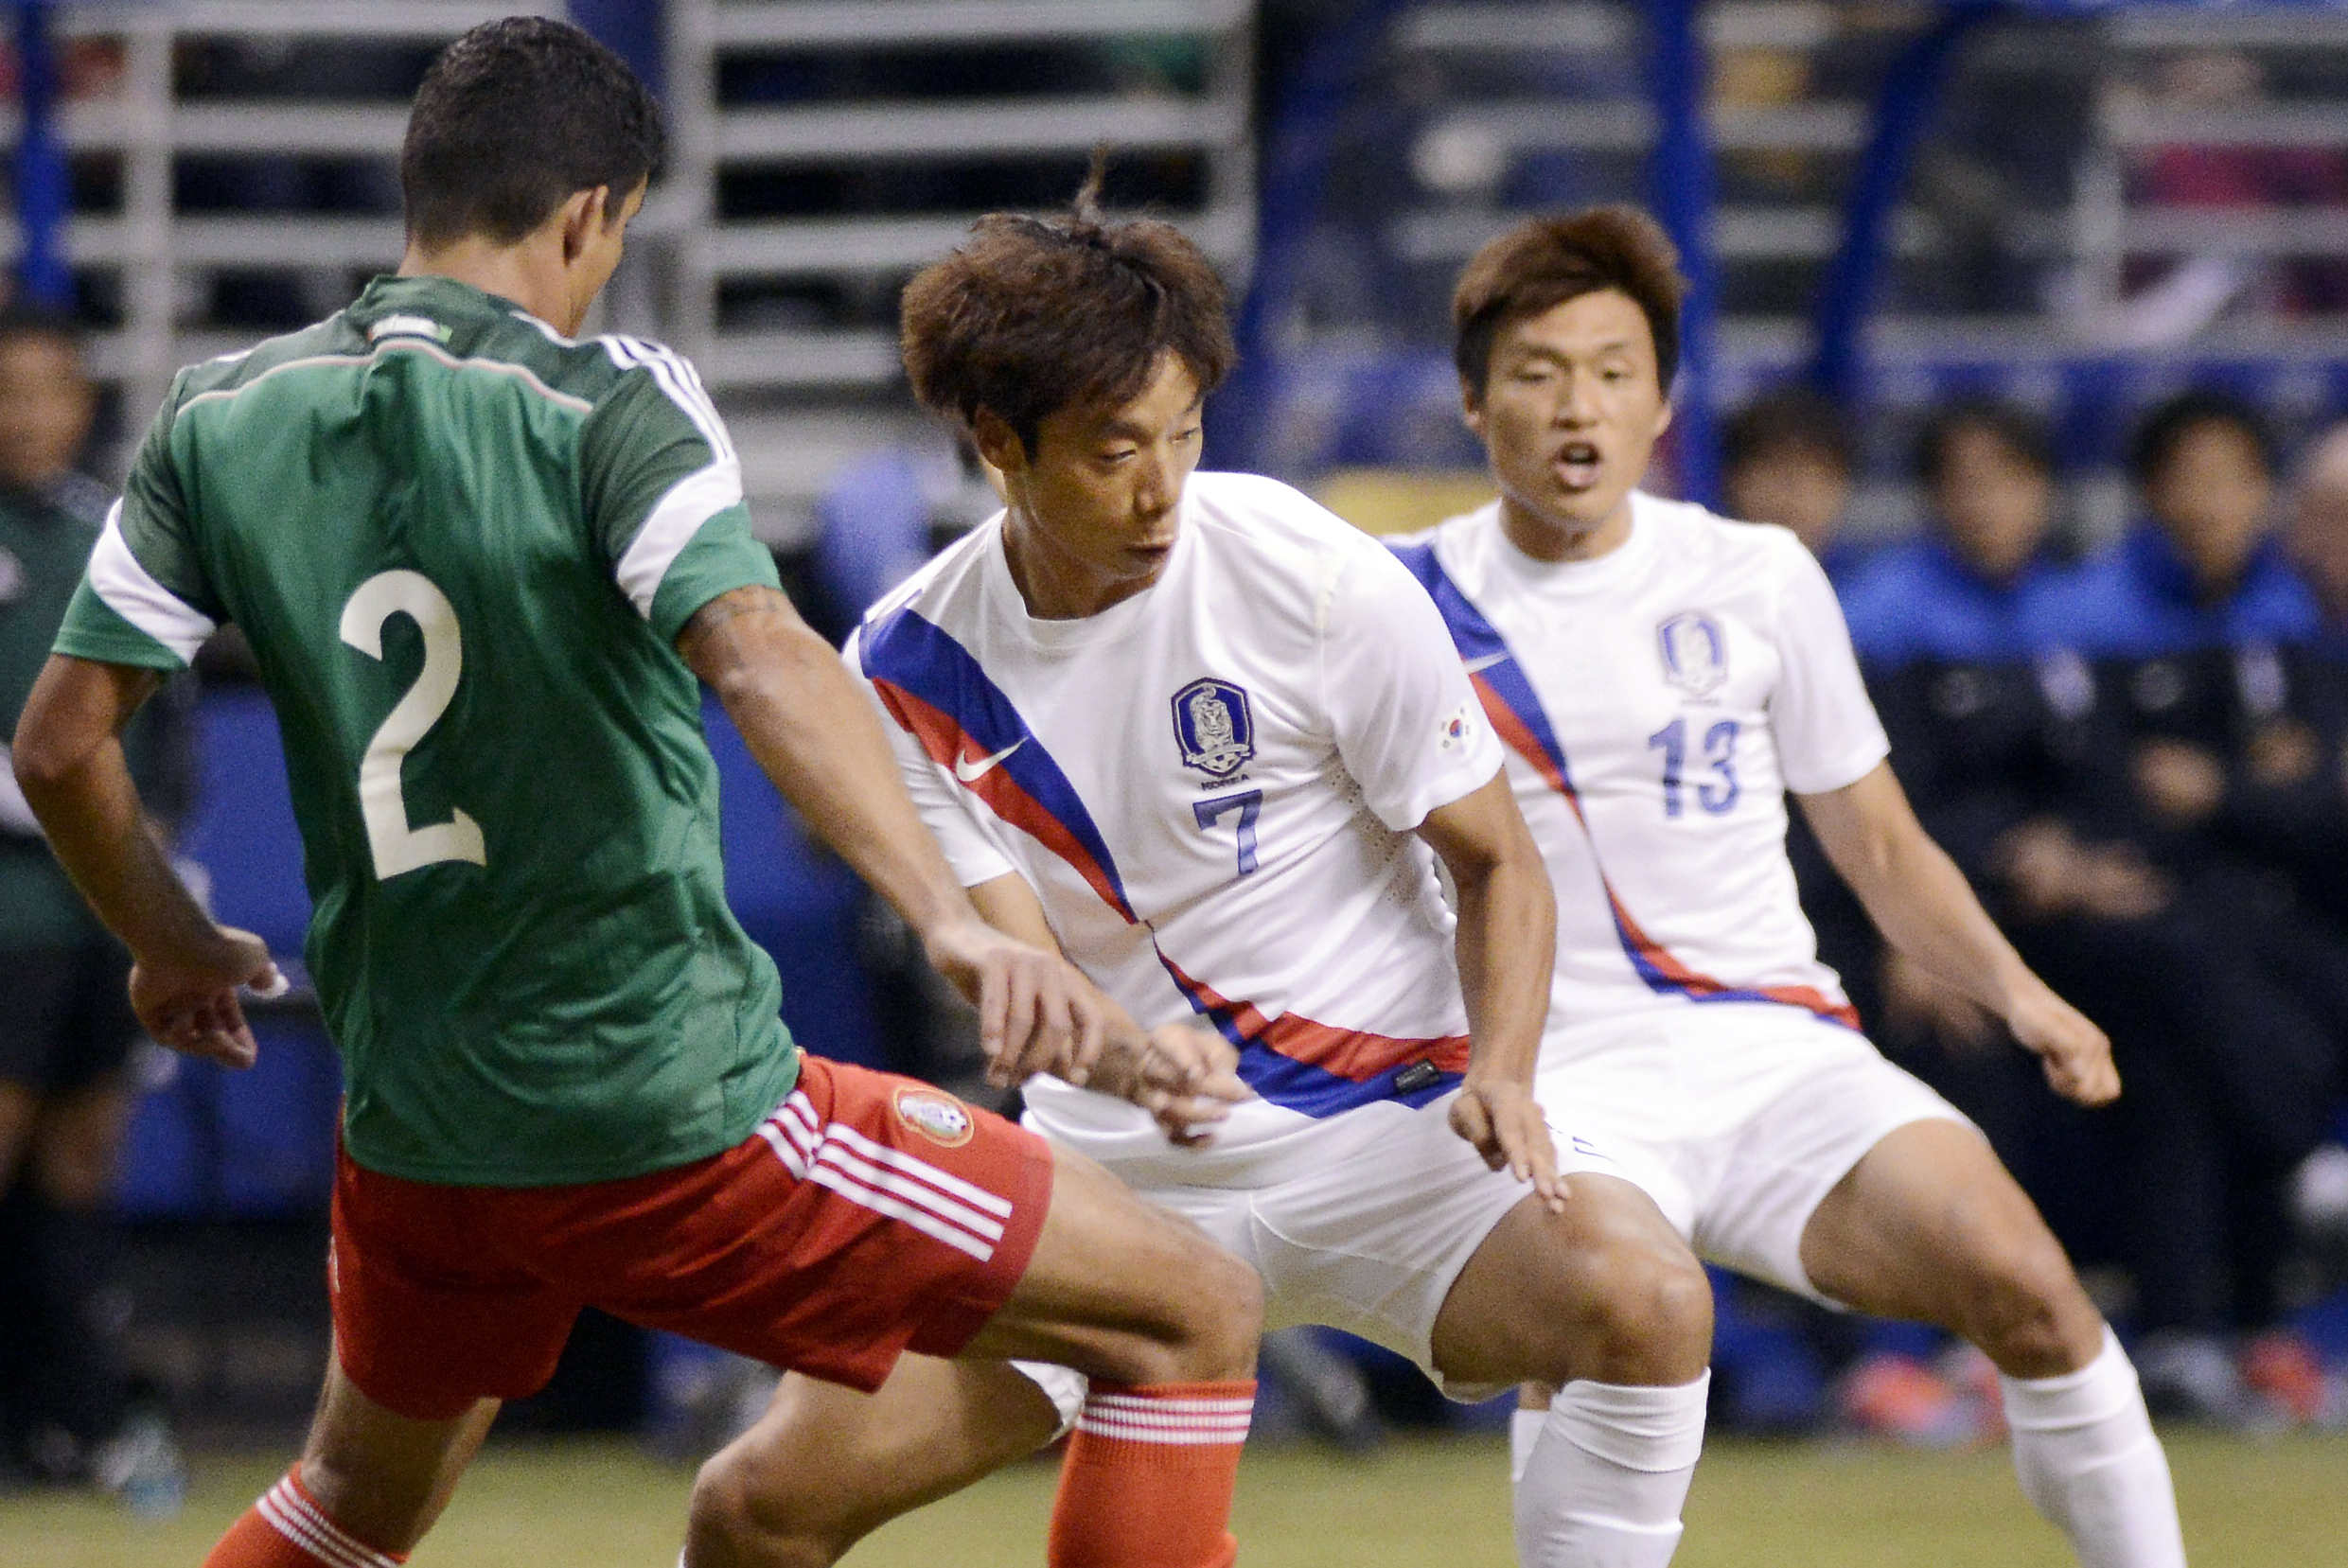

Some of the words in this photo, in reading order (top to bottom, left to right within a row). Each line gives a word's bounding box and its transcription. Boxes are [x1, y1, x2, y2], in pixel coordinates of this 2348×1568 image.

[340, 568, 487, 881] 2
[1649, 719, 1740, 818] 13
[1192, 788, 1263, 874] 7
